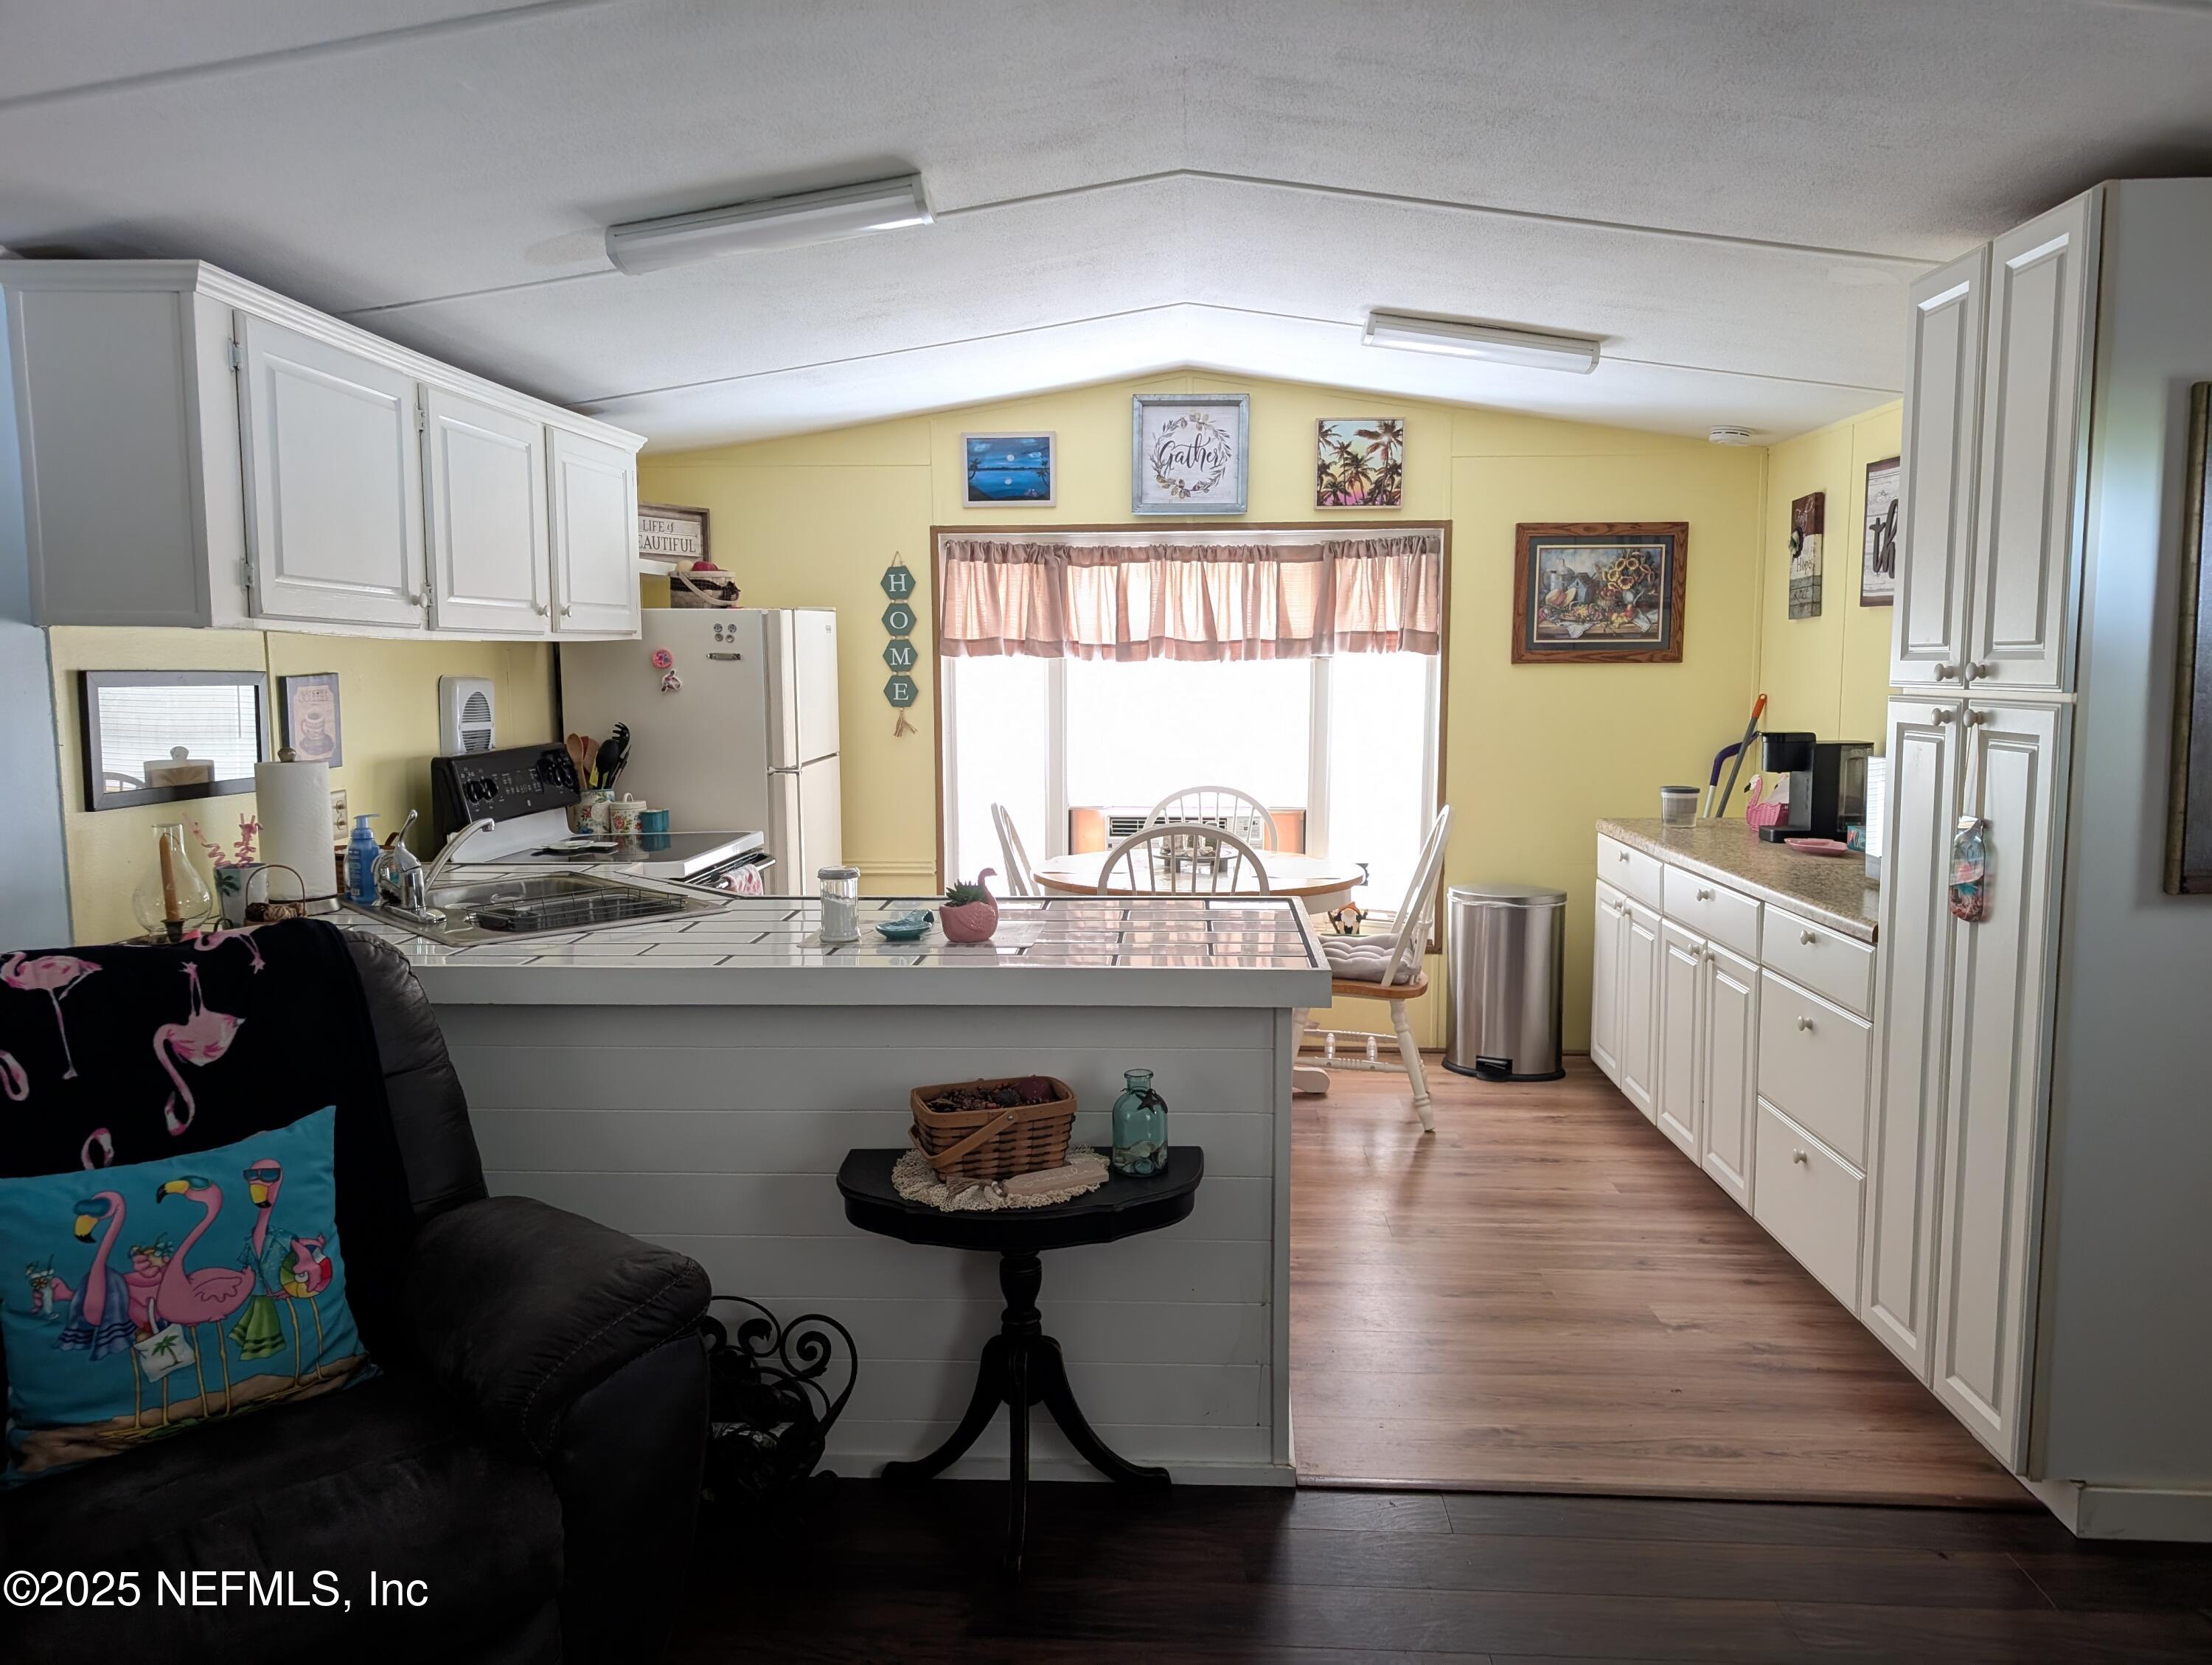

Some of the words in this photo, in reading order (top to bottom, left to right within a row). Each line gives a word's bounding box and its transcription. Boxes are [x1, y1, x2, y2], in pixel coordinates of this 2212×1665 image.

[1159, 433, 1220, 473] Gather
[642, 519, 665, 532] LIFE
[1796, 557, 1812, 575] Hope
[888, 573, 911, 701] HOME
